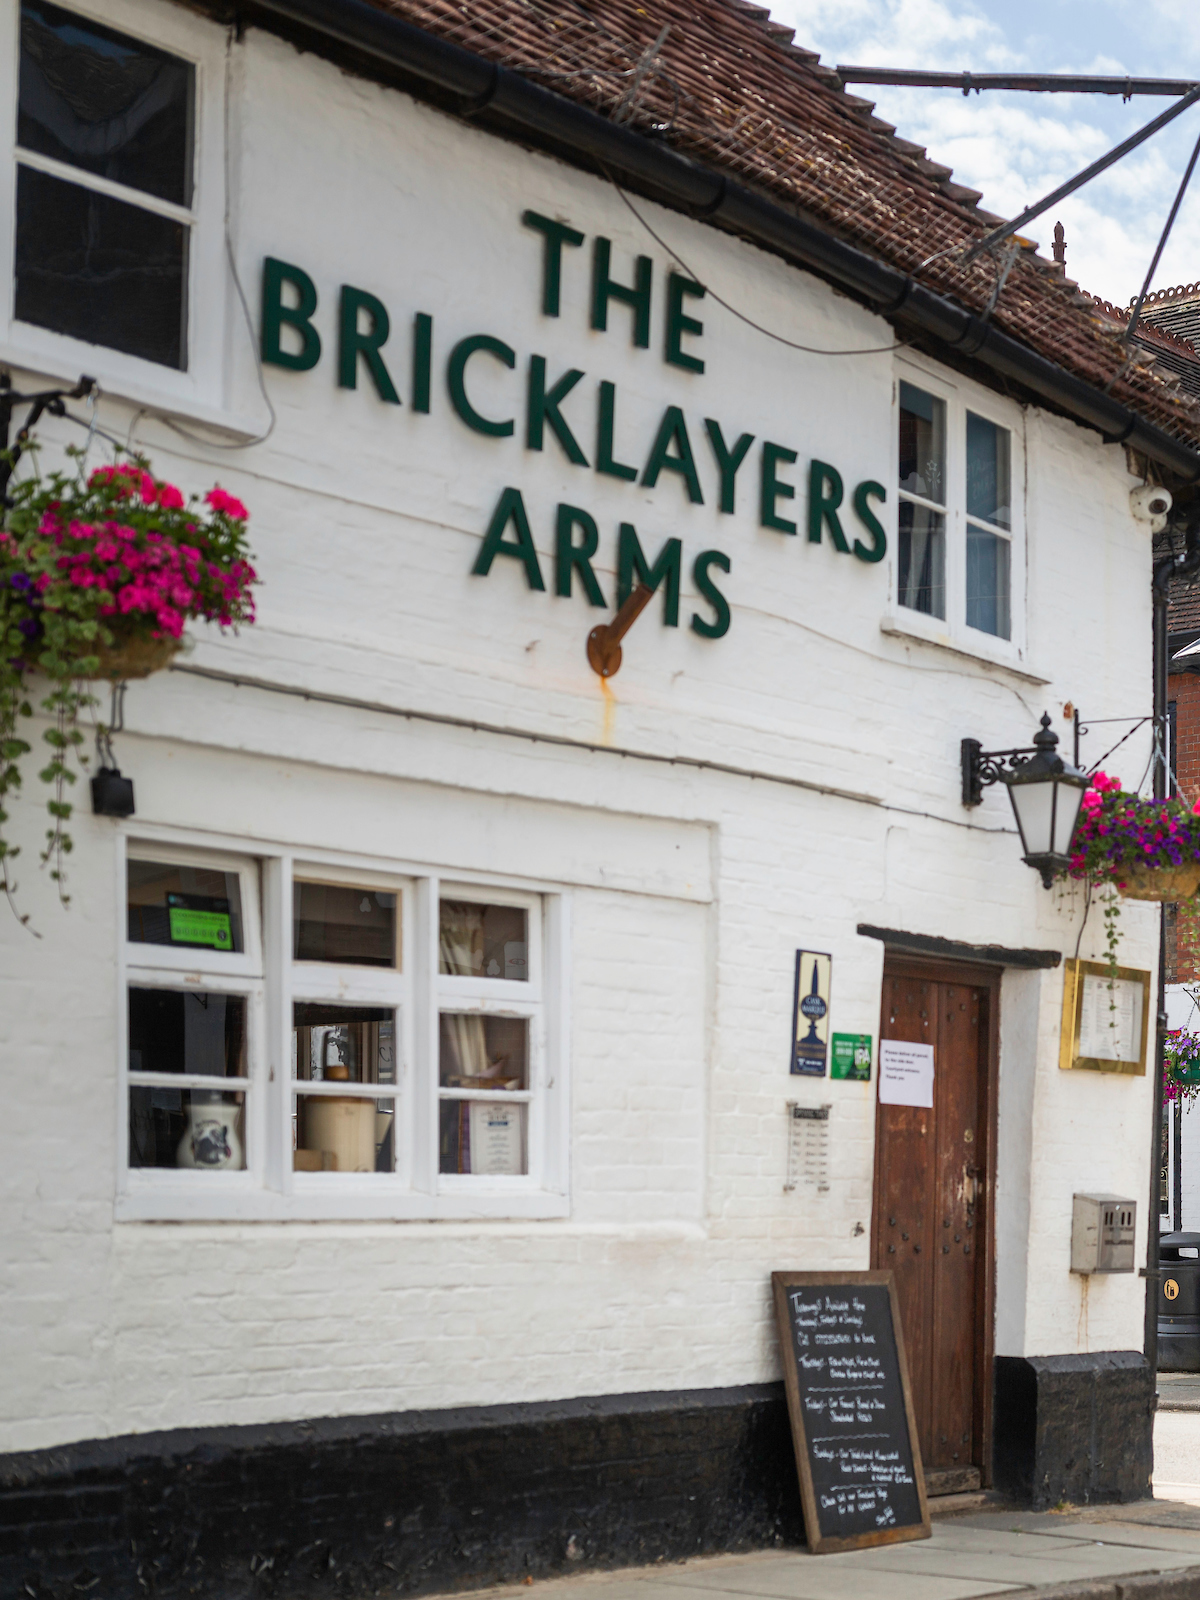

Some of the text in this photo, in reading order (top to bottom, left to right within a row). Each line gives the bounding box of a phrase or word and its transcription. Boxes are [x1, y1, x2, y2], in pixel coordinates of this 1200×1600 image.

[523, 209, 706, 375] THE
[261, 256, 888, 563] BRICKLAYERS
[471, 487, 731, 639] ARMS
[854, 1047, 871, 1066] IPA
